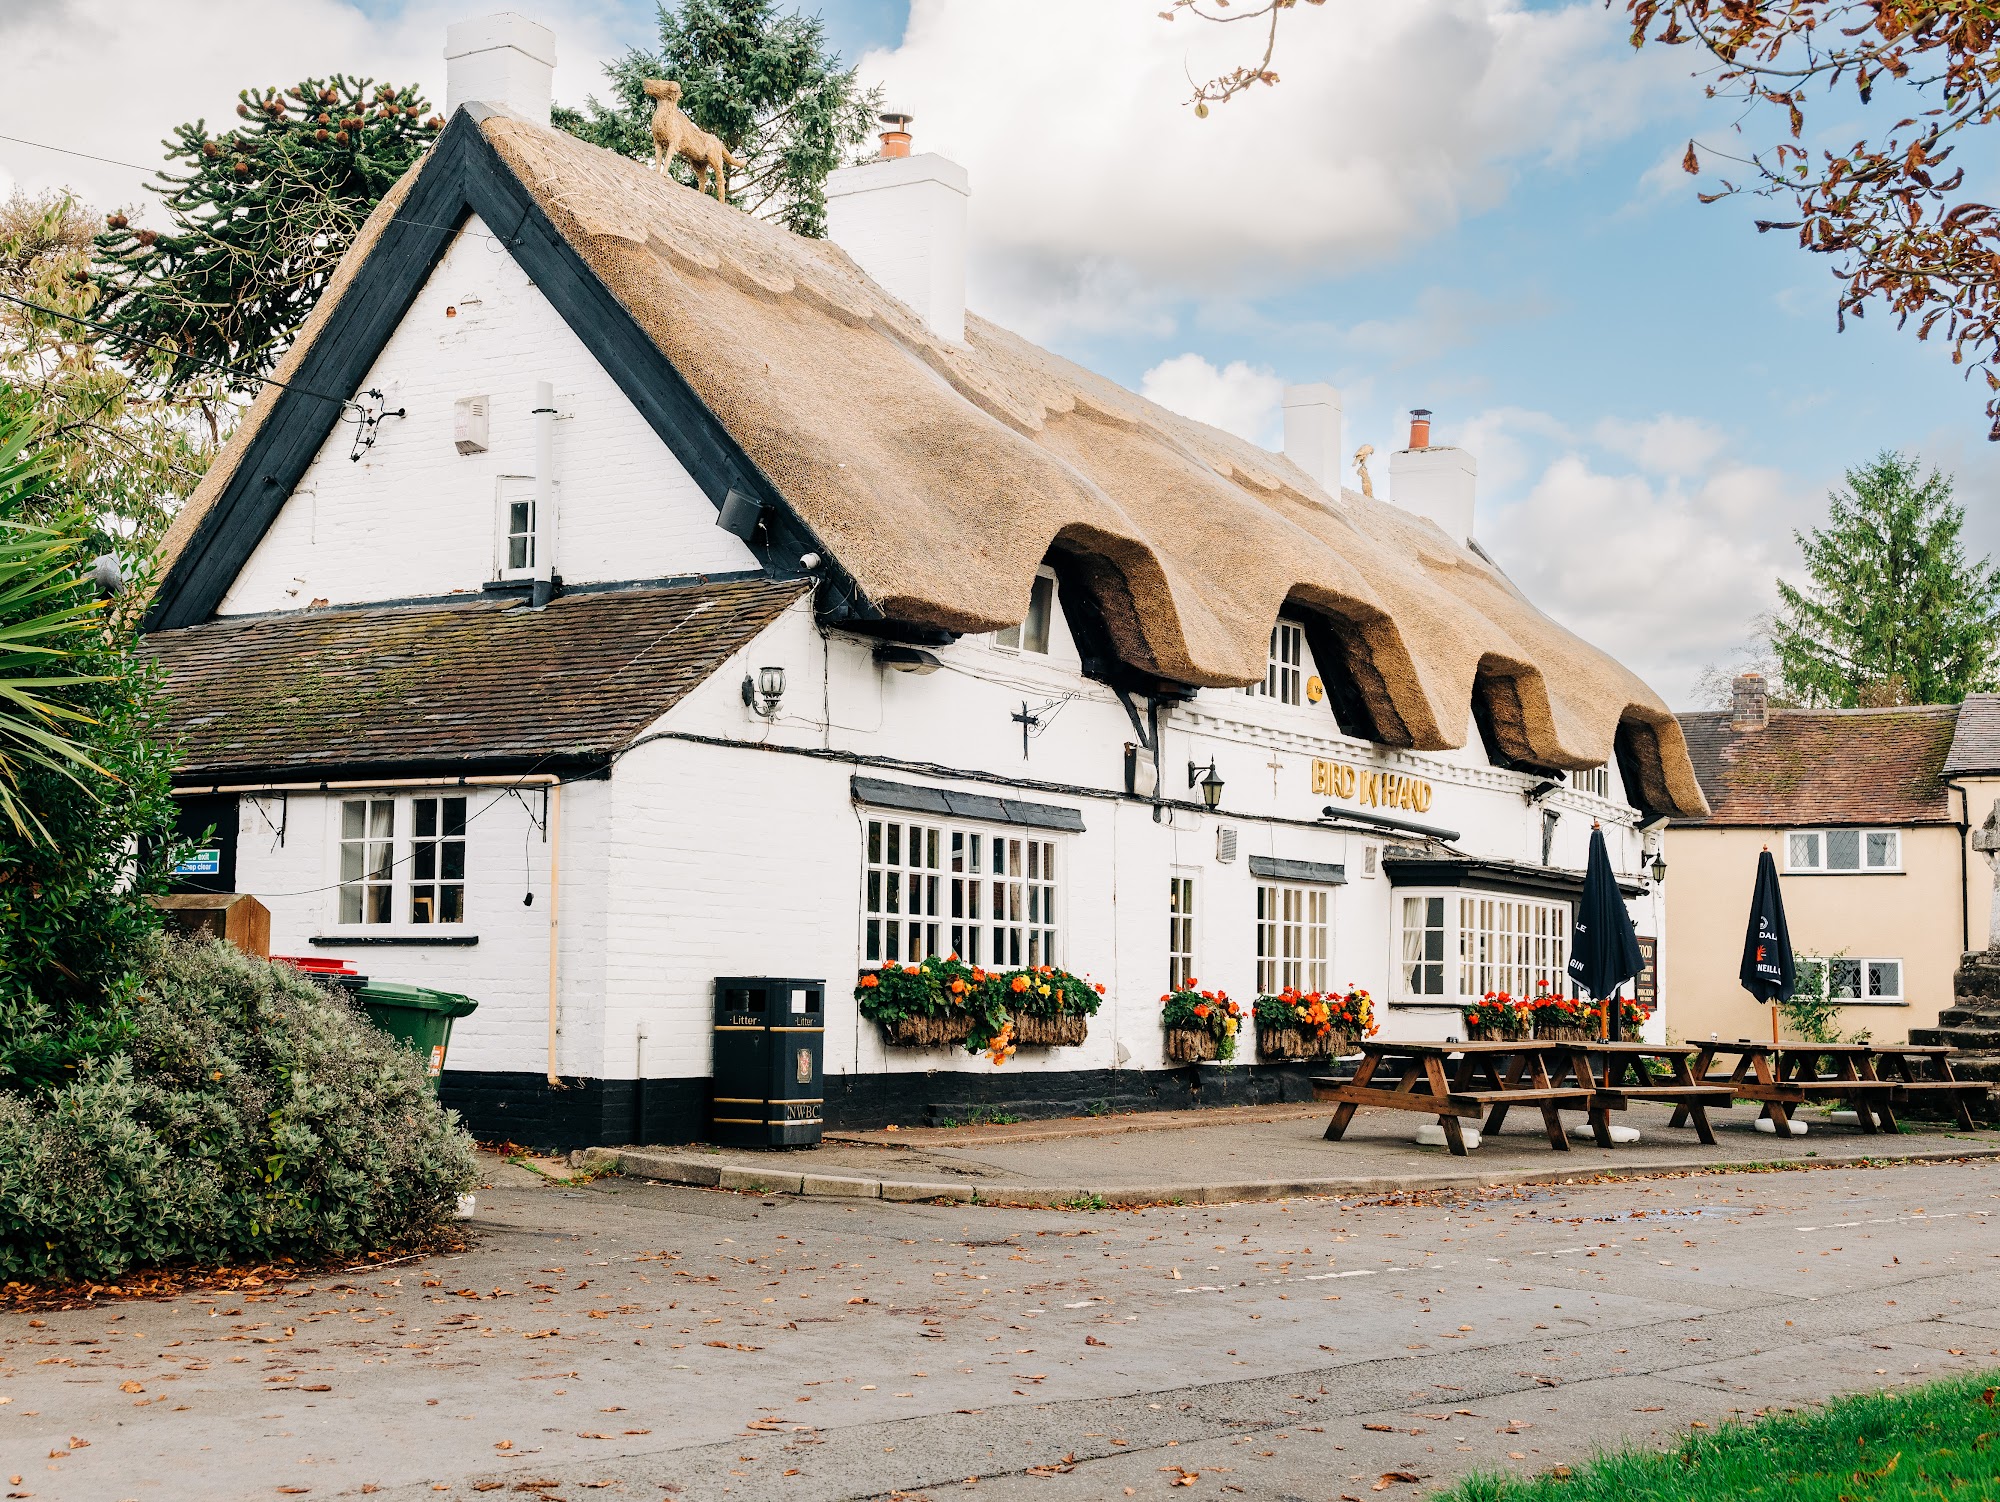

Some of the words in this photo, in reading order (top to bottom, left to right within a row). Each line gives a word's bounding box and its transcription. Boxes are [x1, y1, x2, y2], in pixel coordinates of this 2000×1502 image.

[1312, 758, 1356, 799] BIRD
[1359, 769, 1379, 808] IN
[1381, 772, 1432, 813] HAND
[197, 863, 212, 871] clear
[1569, 958, 1585, 971] GIN
[1756, 963, 1781, 975] NEILL
[732, 1015, 758, 1025] Litter
[796, 1016, 813, 1026] Litter
[788, 1104, 819, 1120] NWBC
